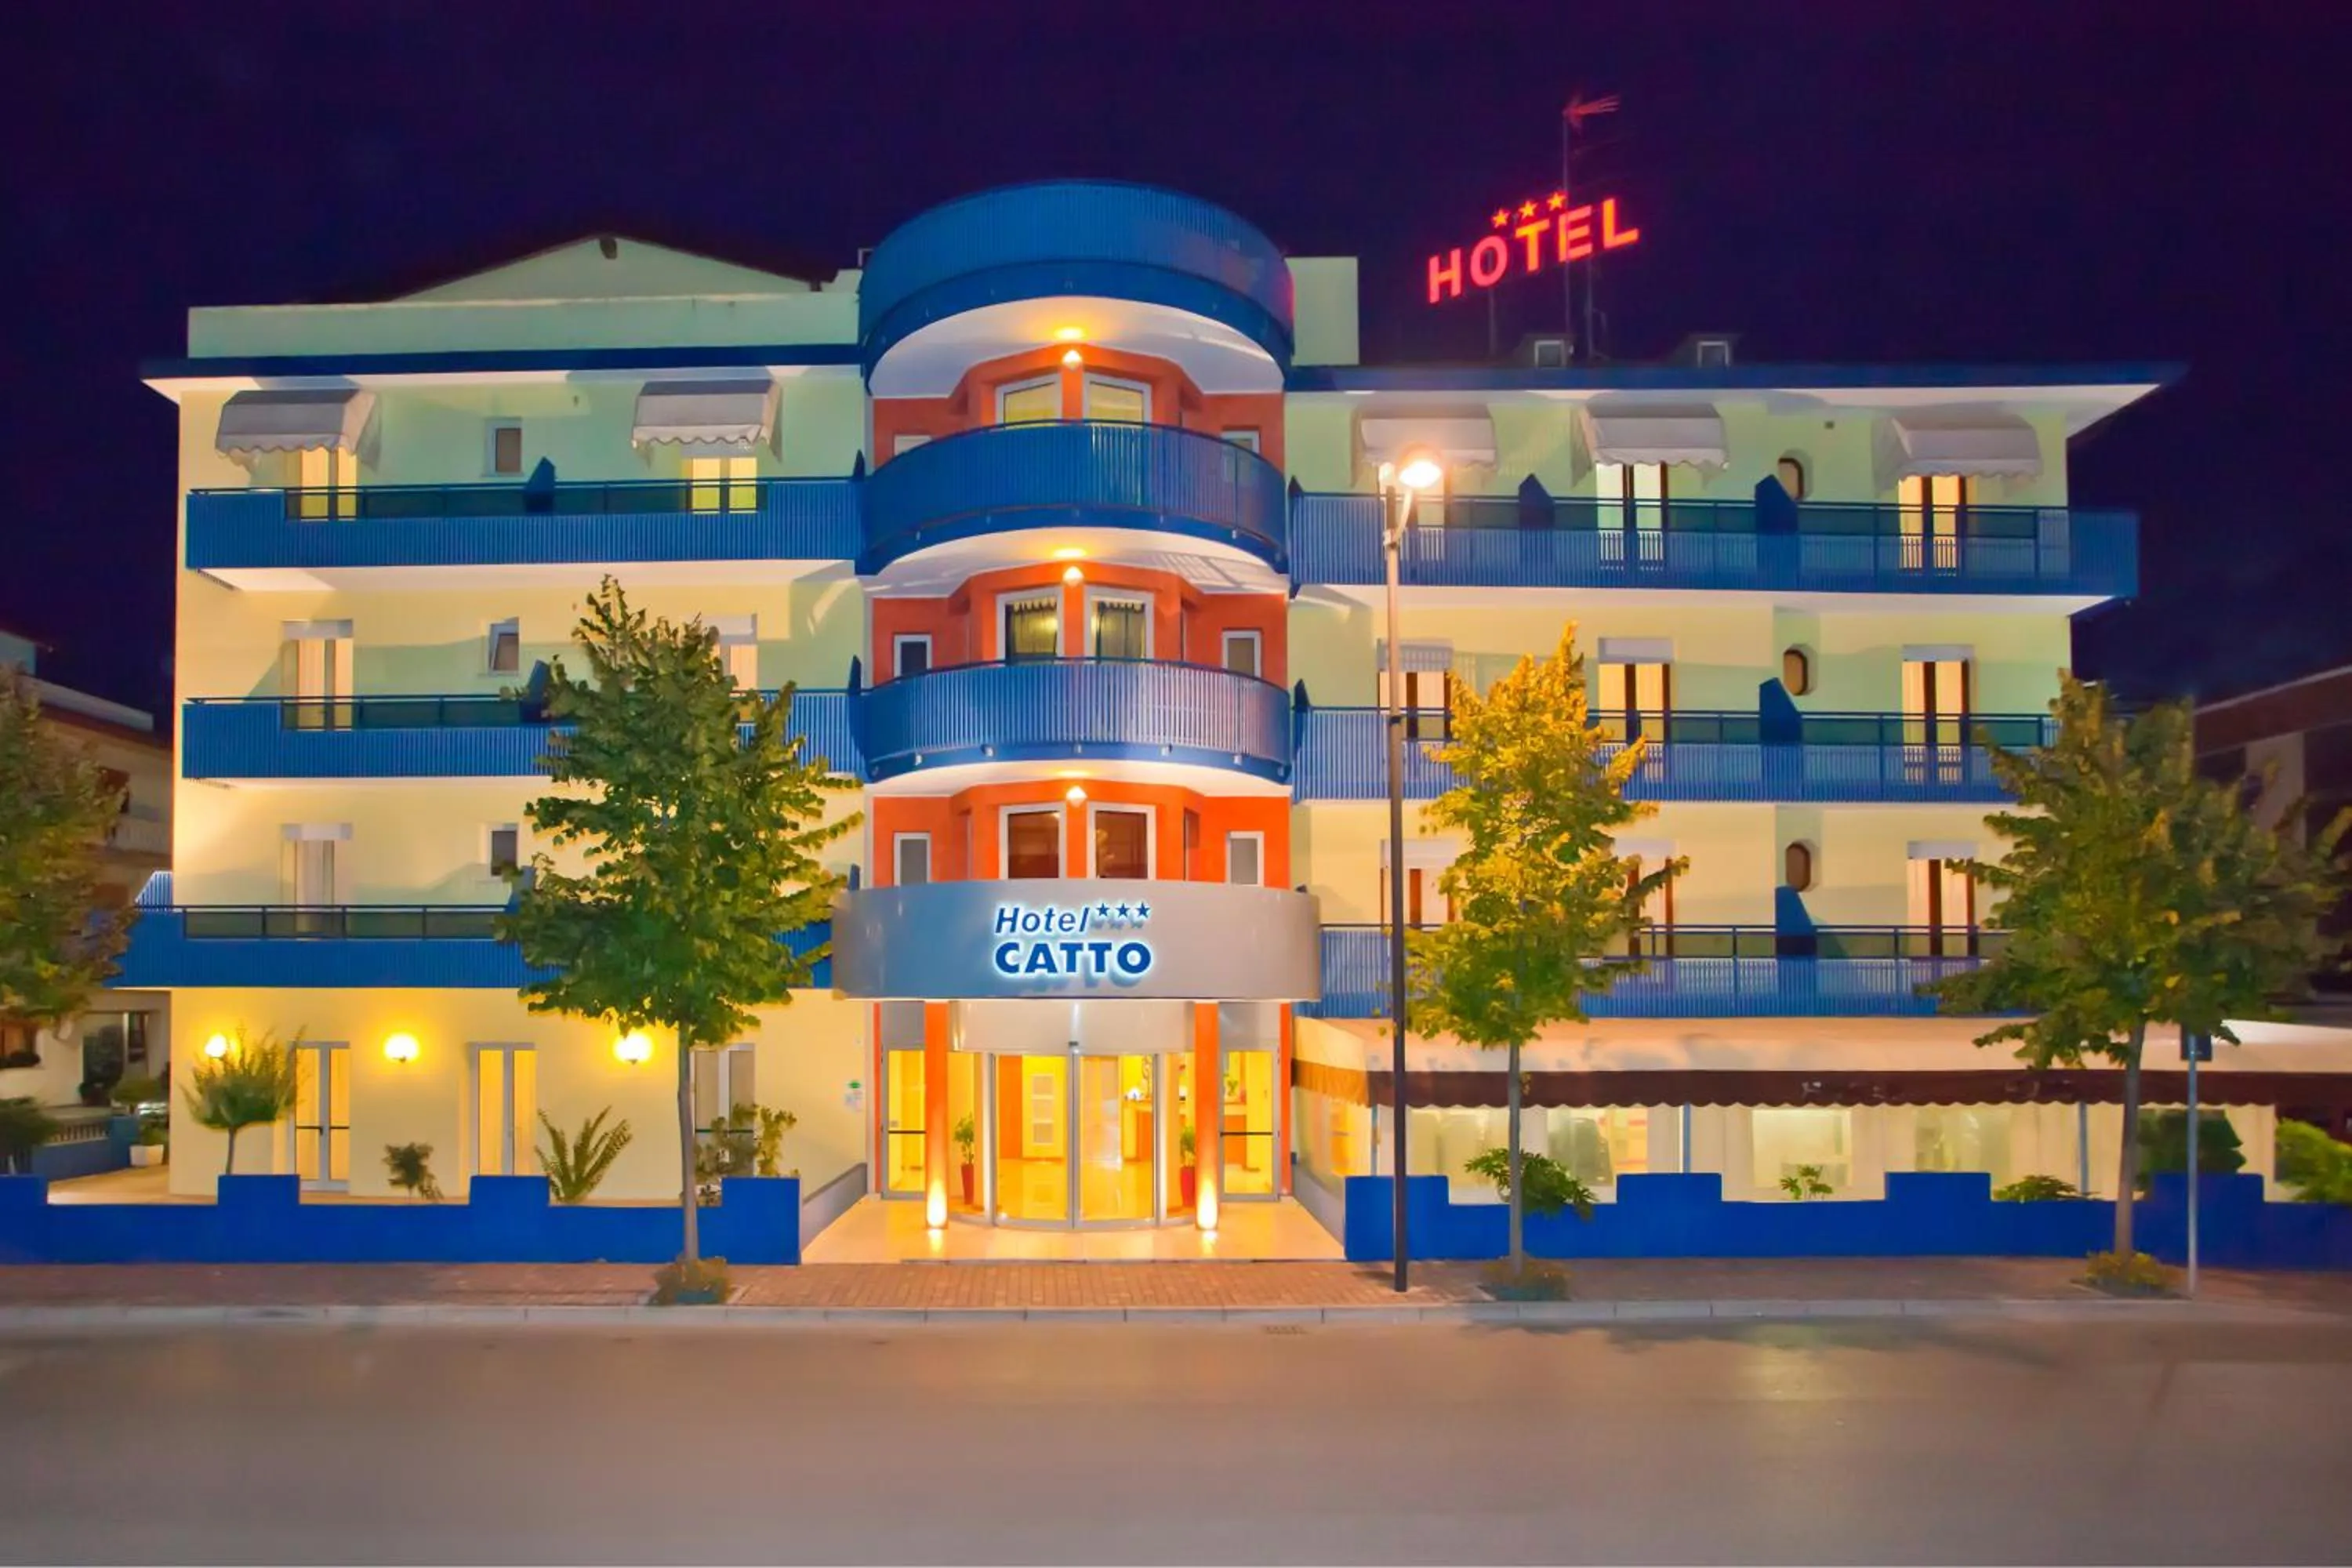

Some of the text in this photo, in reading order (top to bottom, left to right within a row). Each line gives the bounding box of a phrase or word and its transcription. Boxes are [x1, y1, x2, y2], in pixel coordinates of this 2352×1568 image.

[1428, 198, 1640, 303] HOTEL
[995, 907, 1090, 933] Hotel
[995, 942, 1152, 974] CATTO
